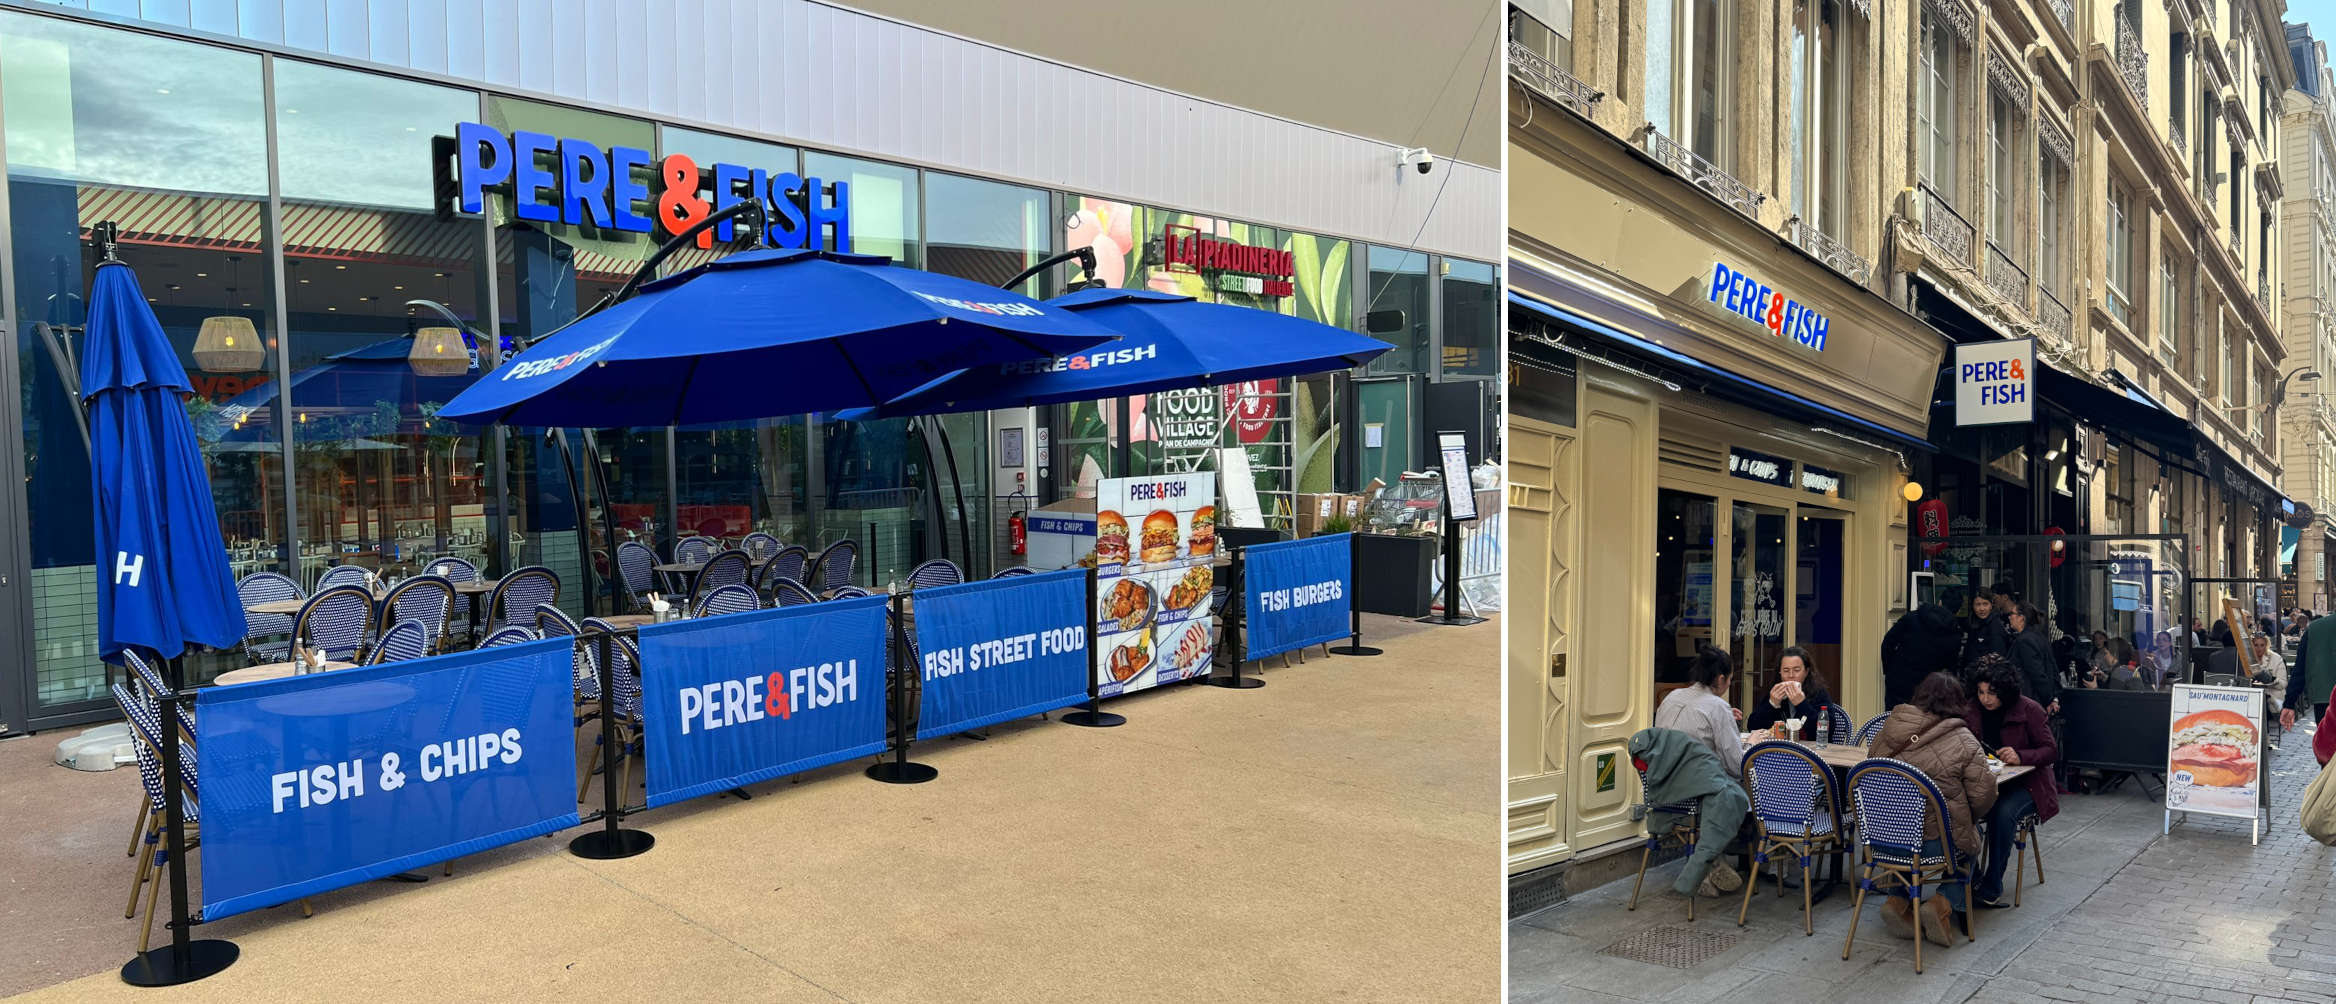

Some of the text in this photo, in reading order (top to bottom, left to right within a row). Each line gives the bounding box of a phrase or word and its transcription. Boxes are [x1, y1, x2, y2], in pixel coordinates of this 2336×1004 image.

[457, 121, 850, 254] PERE&FISH
[1170, 234, 1294, 276] LA PIADINERIA
[1222, 272, 1247, 293] STREET
[1246, 277, 1263, 295] FOOD
[1707, 261, 1830, 352] PERE&FISH
[1962, 358, 2025, 384] PERE&
[1981, 383, 2025, 406] FISH
[1156, 416, 1214, 438] VILLAGE
[1131, 481, 1187, 501] PERE&FISH
[1041, 520, 1084, 532] FISH & CHIPS
[1099, 564, 1120, 576] BURGERS
[1260, 579, 1342, 613] FISH BURGERS
[925, 626, 1085, 681] FISH STREET FOOD
[679, 658, 857, 735] PERE&FISH
[272, 727, 523, 814] FISH & CHIPS
[2176, 774, 2191, 782] NEW
